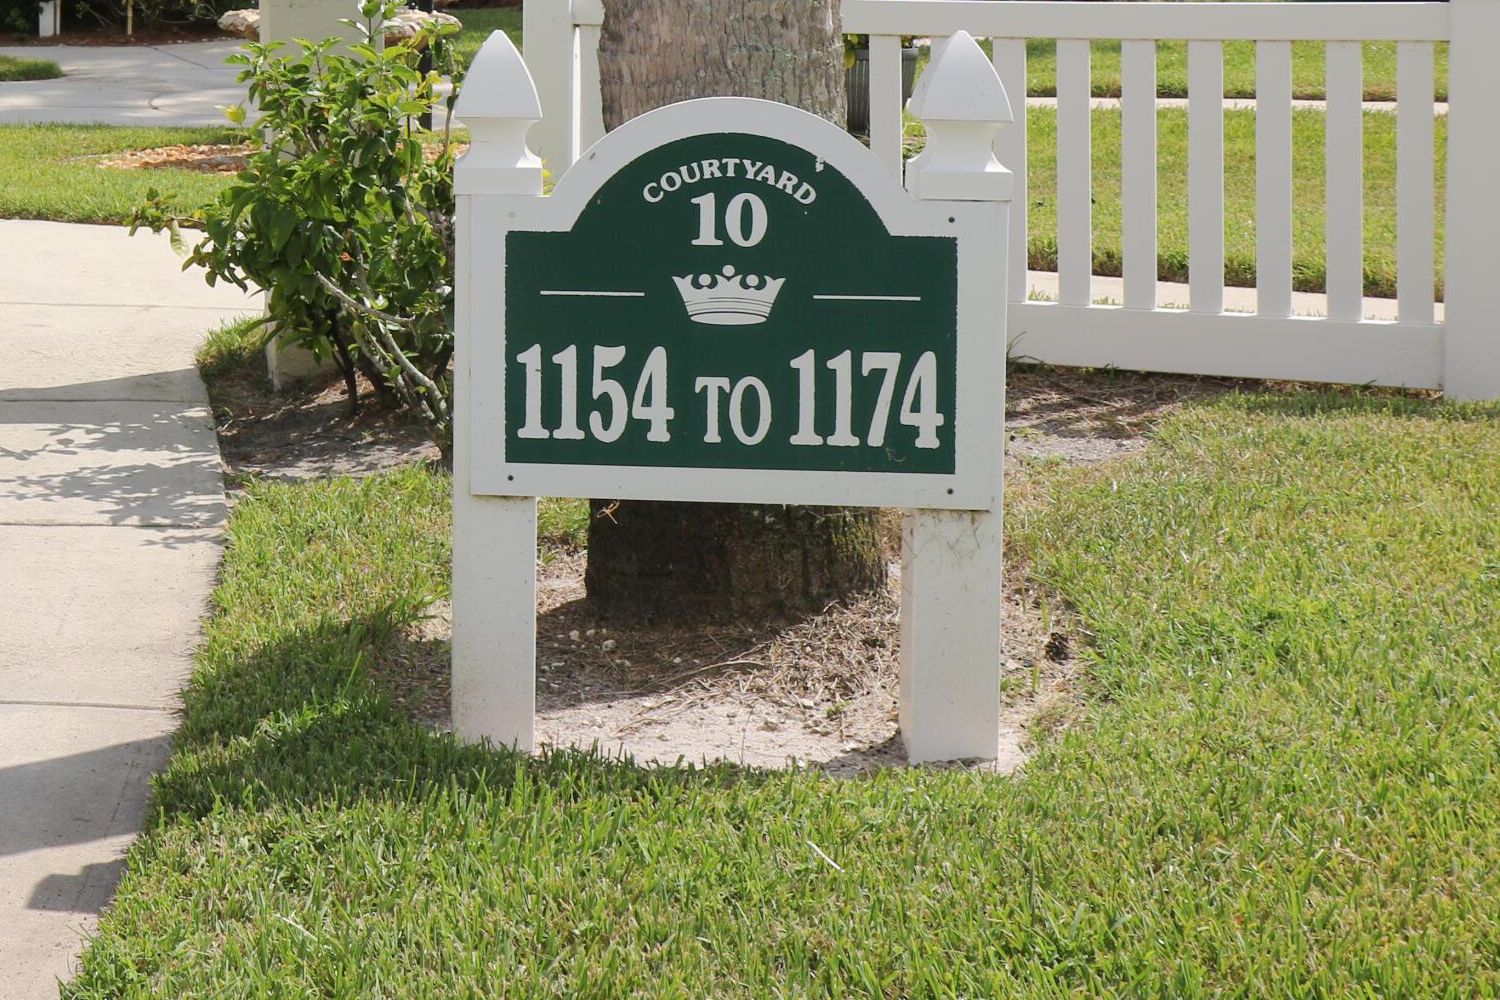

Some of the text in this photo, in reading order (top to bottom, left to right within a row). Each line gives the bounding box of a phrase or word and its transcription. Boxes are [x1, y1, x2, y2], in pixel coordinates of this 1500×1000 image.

[643, 158, 817, 205] COURTYARD
[690, 192, 768, 248] 10
[516, 343, 944, 449] 1154 TO 1174
